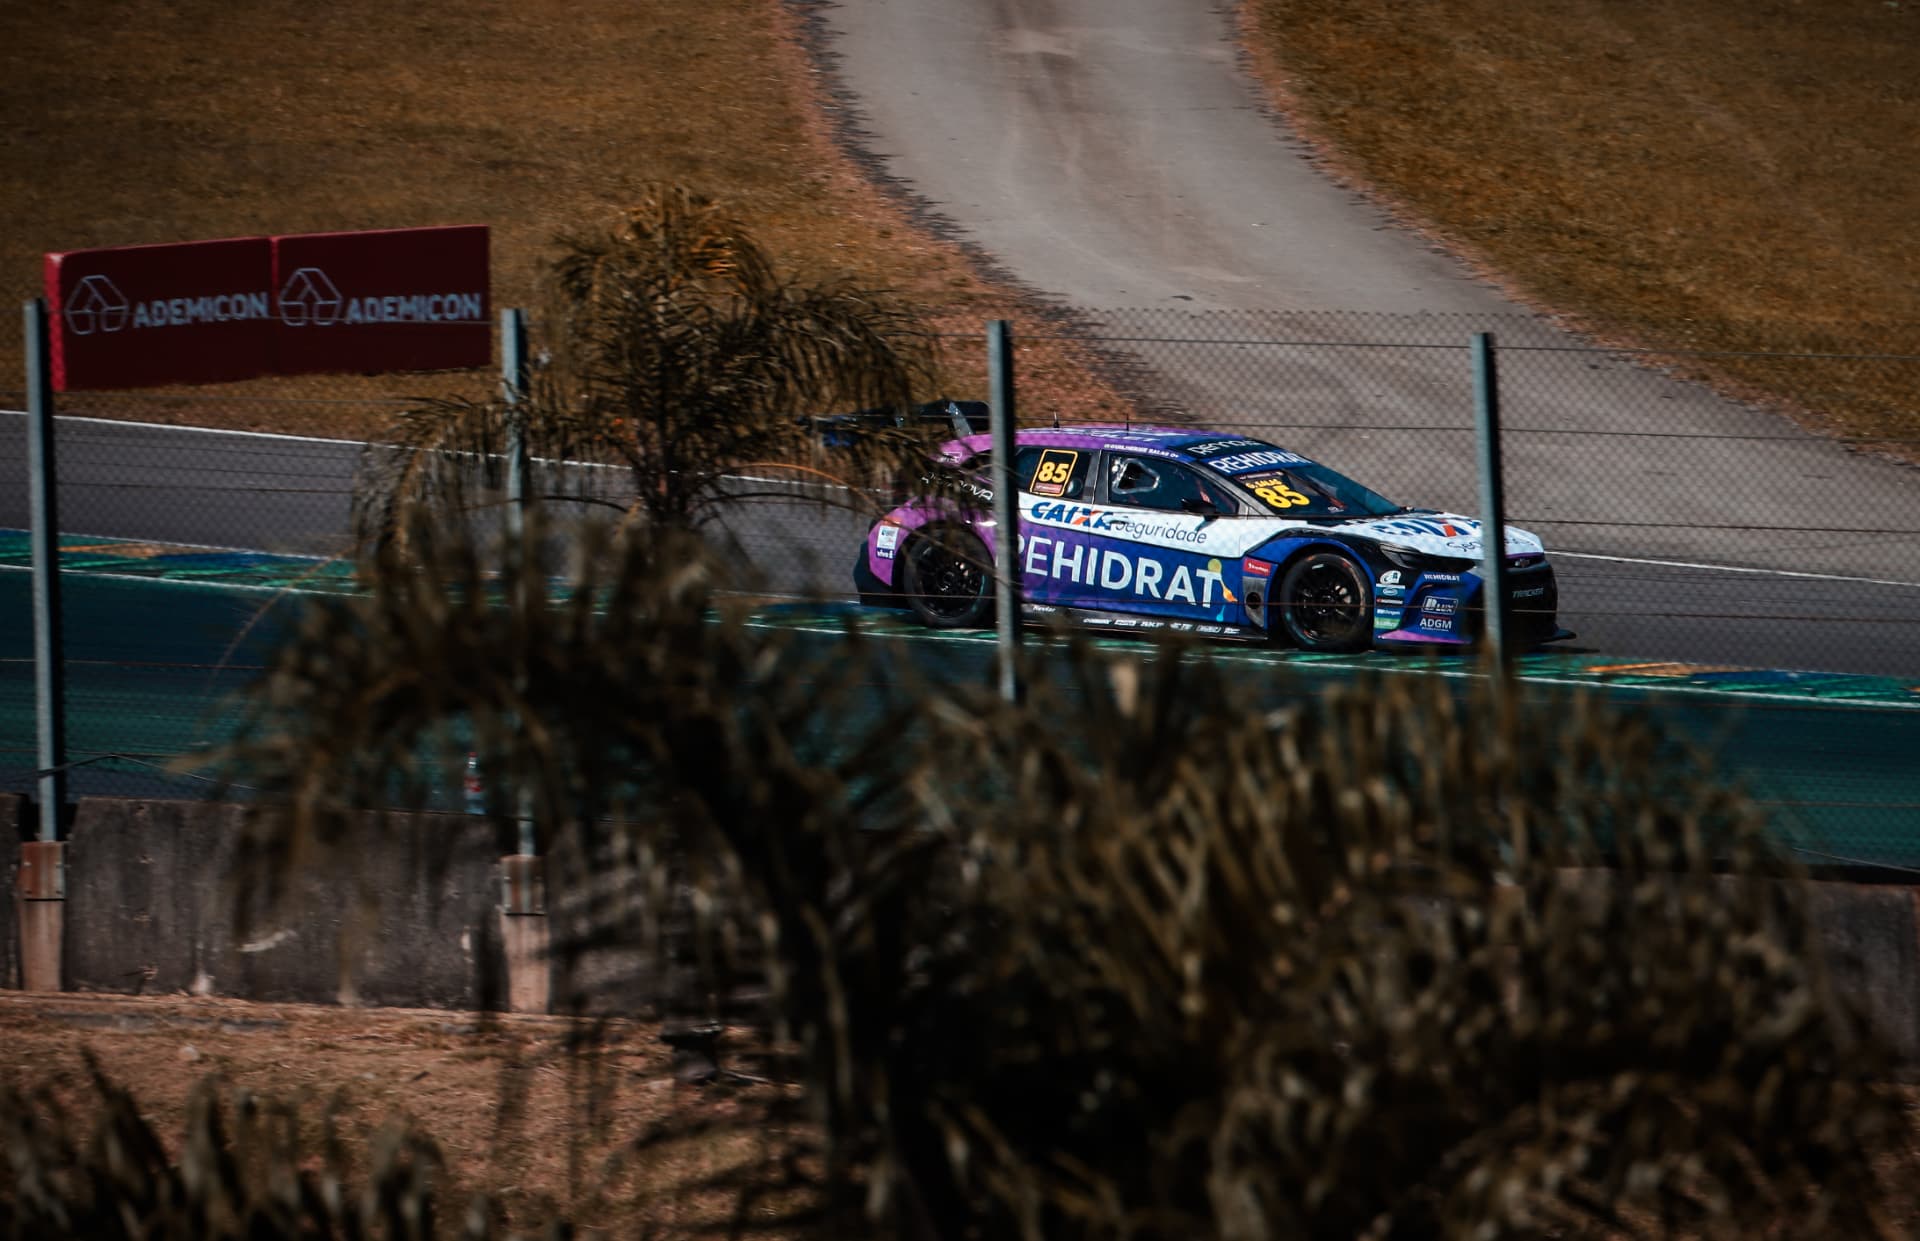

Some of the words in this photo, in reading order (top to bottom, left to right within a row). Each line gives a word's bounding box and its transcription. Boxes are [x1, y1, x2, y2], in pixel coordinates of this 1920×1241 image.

[133, 292, 269, 328] ADEMICON
[345, 293, 481, 324] ADEMICON
[1038, 461, 1069, 483] 85
[1254, 485, 1310, 508] 85
[1031, 502, 1113, 530] CAIXA
[1116, 516, 1207, 544] Seguridade
[1018, 534, 1221, 608] EHIDRAT
[1420, 618, 1452, 629] ADGM
